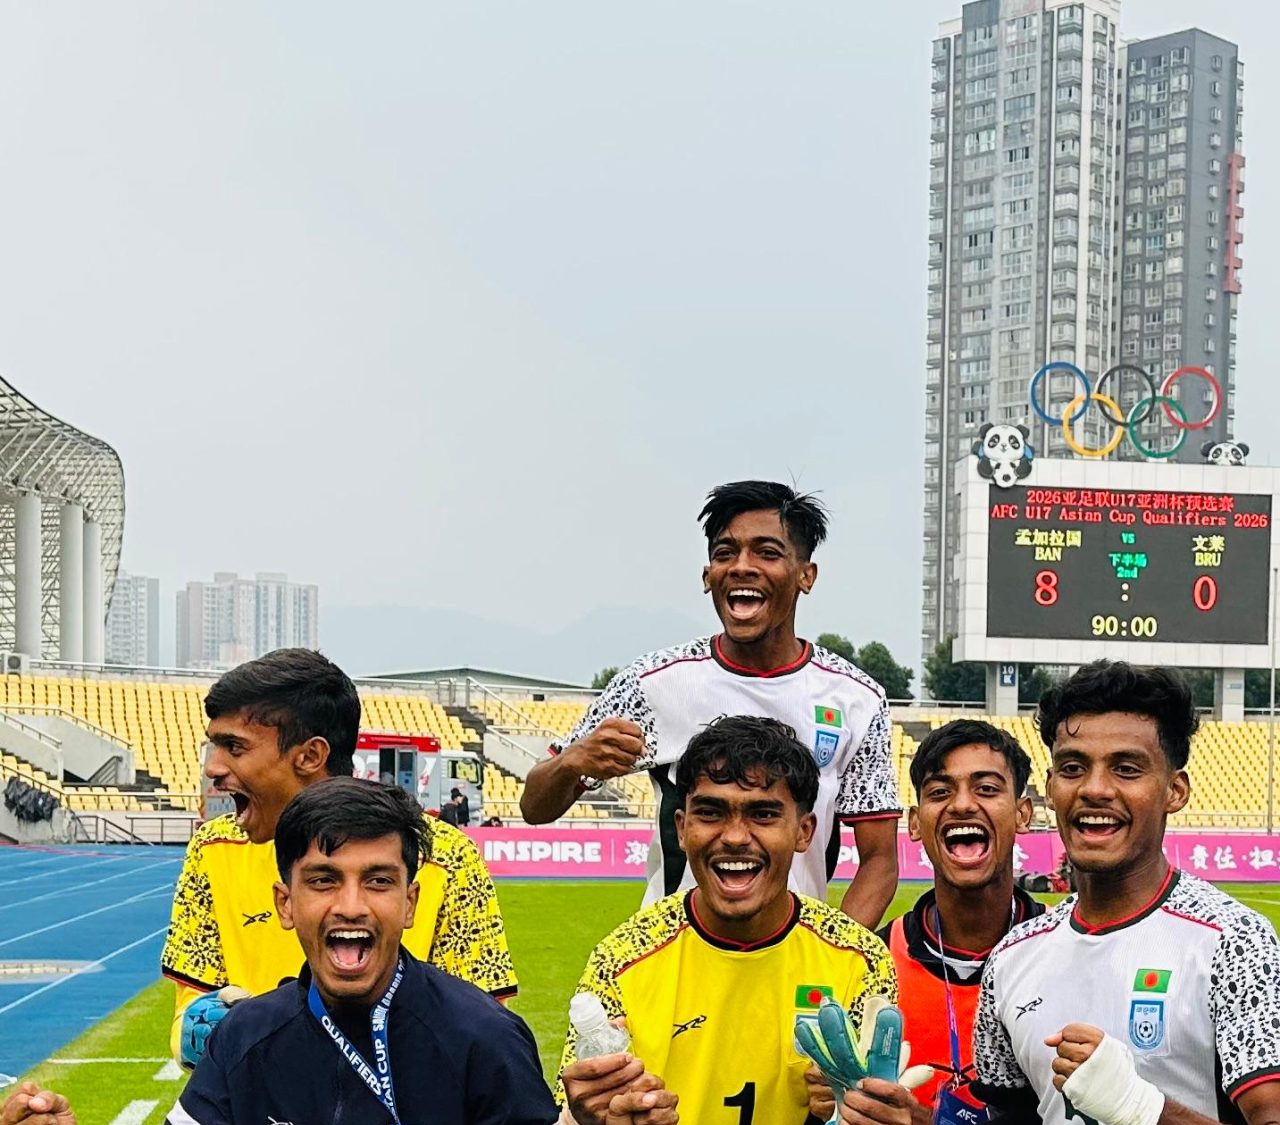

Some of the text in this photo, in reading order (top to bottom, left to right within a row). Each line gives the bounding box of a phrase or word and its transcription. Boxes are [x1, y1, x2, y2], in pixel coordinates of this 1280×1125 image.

[991, 504, 1268, 528] AFC U17 Asian Cup Qualifiers 2026
[1014, 529, 1082, 547] 孟加拉国
[1192, 535, 1225, 552] 文莱
[1034, 547, 1062, 561] BAN
[1194, 553, 1221, 567] BRU
[1117, 567, 1138, 578] 2nd
[1035, 571, 1058, 605] 8
[1193, 575, 1217, 611] 0
[1091, 615, 1158, 637] 90:00
[1002, 665, 1014, 675] 10
[484, 840, 602, 863] INSPIRE
[321, 1015, 382, 1096] QUALIFIERS
[374, 1038, 388, 1073] CUP
[956, 1108, 978, 1125] AFC
